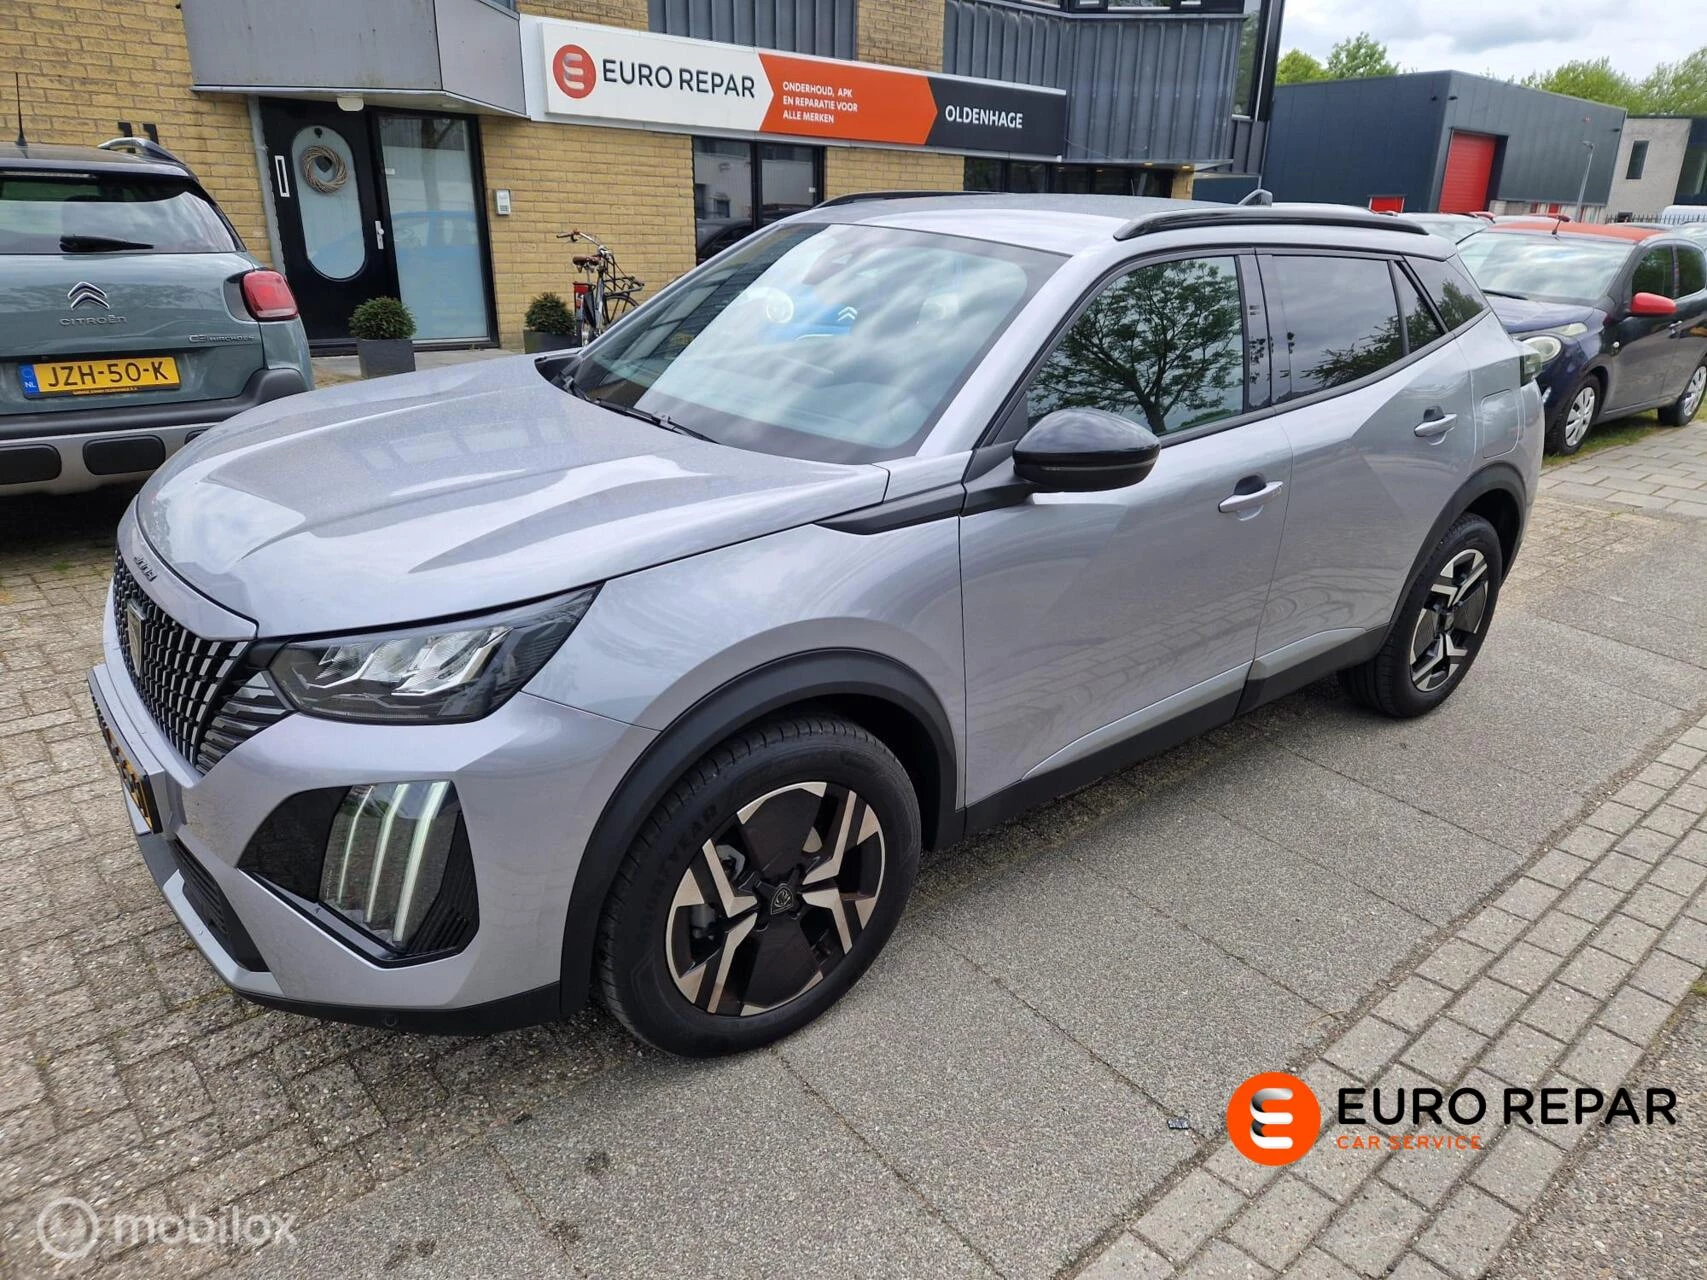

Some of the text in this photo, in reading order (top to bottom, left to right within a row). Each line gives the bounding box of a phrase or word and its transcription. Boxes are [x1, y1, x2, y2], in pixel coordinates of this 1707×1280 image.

[602, 58, 755, 99] EURO REPAR
[782, 81, 853, 98] ONDERHOUD, APK
[783, 95, 858, 112] EN REPARATIE VOOR
[782, 109, 835, 123] ALLE MERKEN
[944, 104, 1023, 129] OLDENHAGE
[47, 361, 169, 388] JZH-50-K
[24, 381, 37, 389] NL
